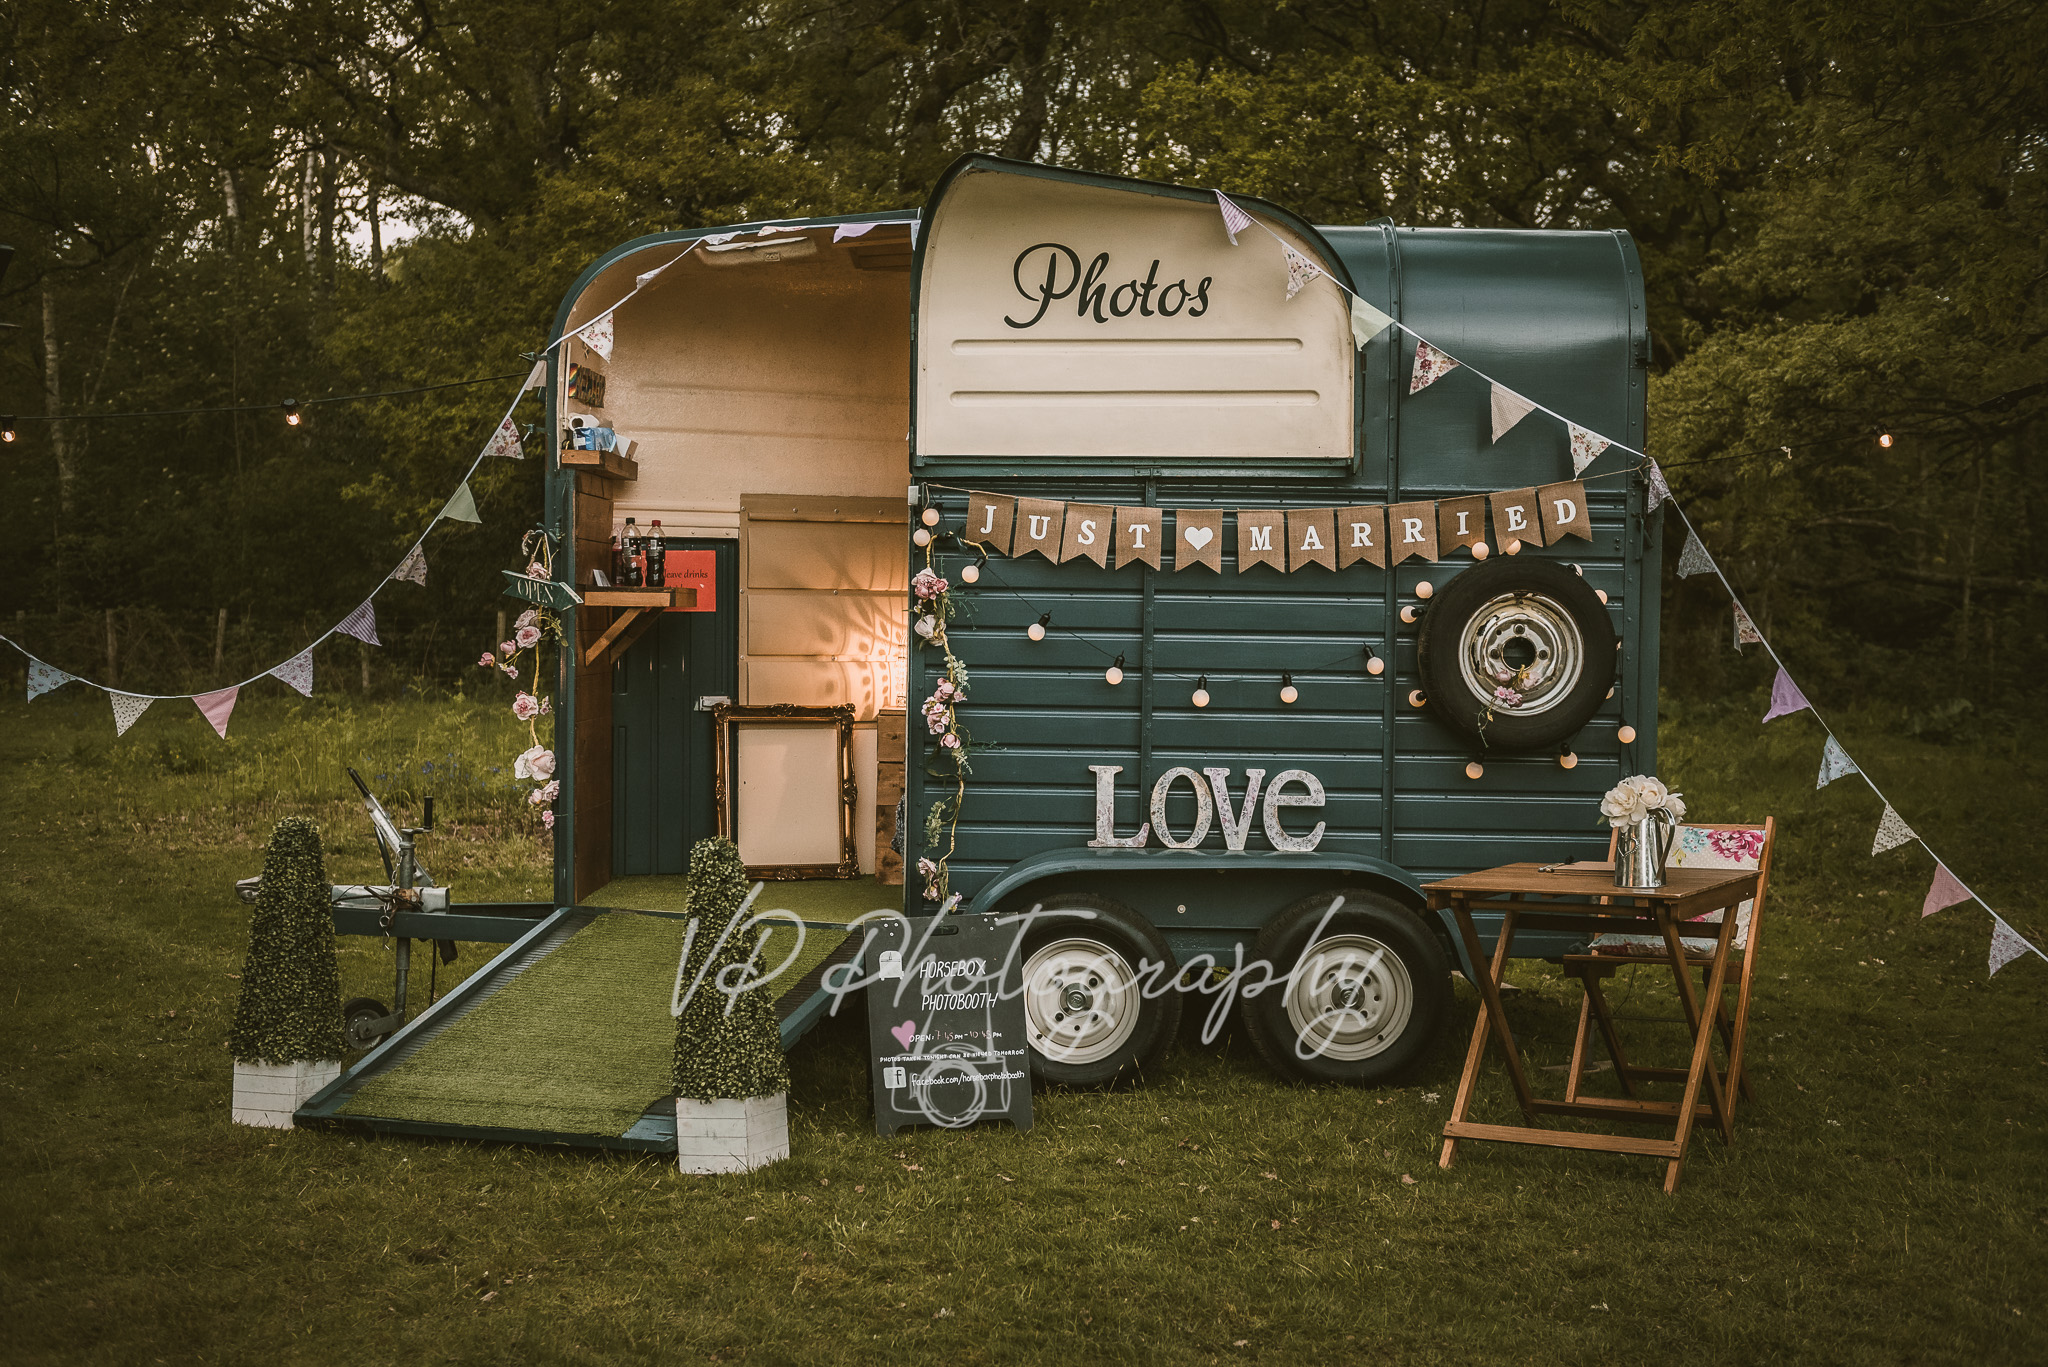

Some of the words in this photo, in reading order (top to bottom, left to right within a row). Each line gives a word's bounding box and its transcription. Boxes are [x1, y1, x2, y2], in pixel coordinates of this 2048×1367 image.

[1003, 242, 1213, 329] Photos
[979, 504, 1151, 550] JUST
[1248, 498, 1578, 551] MARRIED
[684, 569, 709, 579] drinks
[517, 580, 554, 603] OPEN
[919, 960, 987, 979] HORSEBOX
[921, 992, 999, 1011] PHOTOBOOTH
[923, 1053, 947, 1061] TONIGHT
